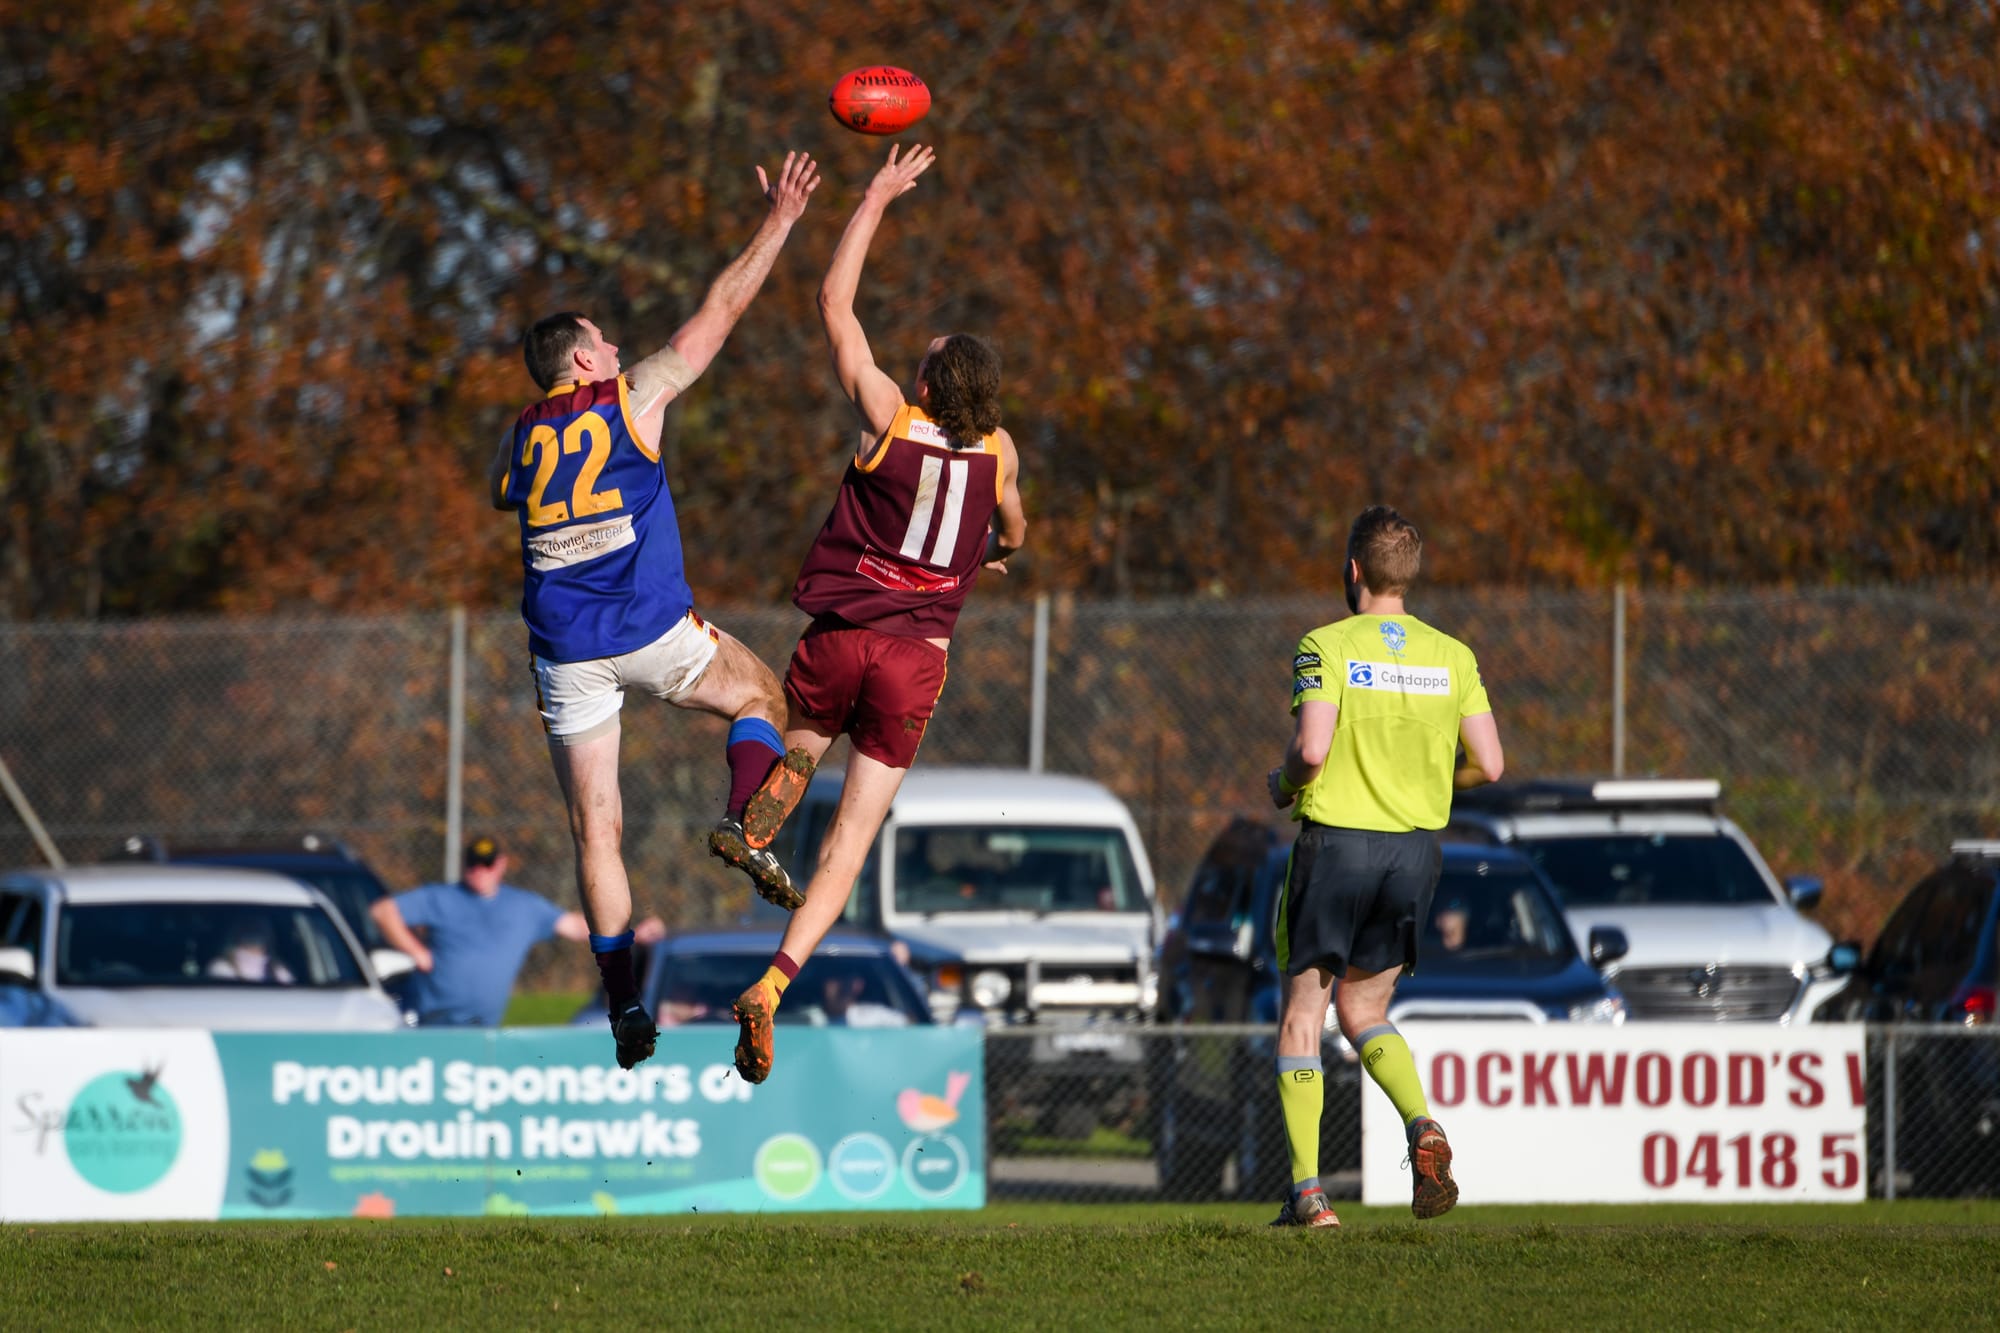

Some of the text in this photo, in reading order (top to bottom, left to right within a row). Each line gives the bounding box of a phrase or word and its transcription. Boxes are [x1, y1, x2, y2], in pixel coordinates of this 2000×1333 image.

[522, 411, 623, 526] 22
[899, 454, 969, 568] 11
[1381, 671, 1449, 689] Candappa
[272, 1058, 434, 1106] Proud
[443, 1060, 693, 1111] Sponsors
[1428, 1050, 1826, 1108] OCKWOOD'S
[327, 1110, 702, 1160] Drouin Hawks
[1641, 1131, 1860, 1190] 0418 5
